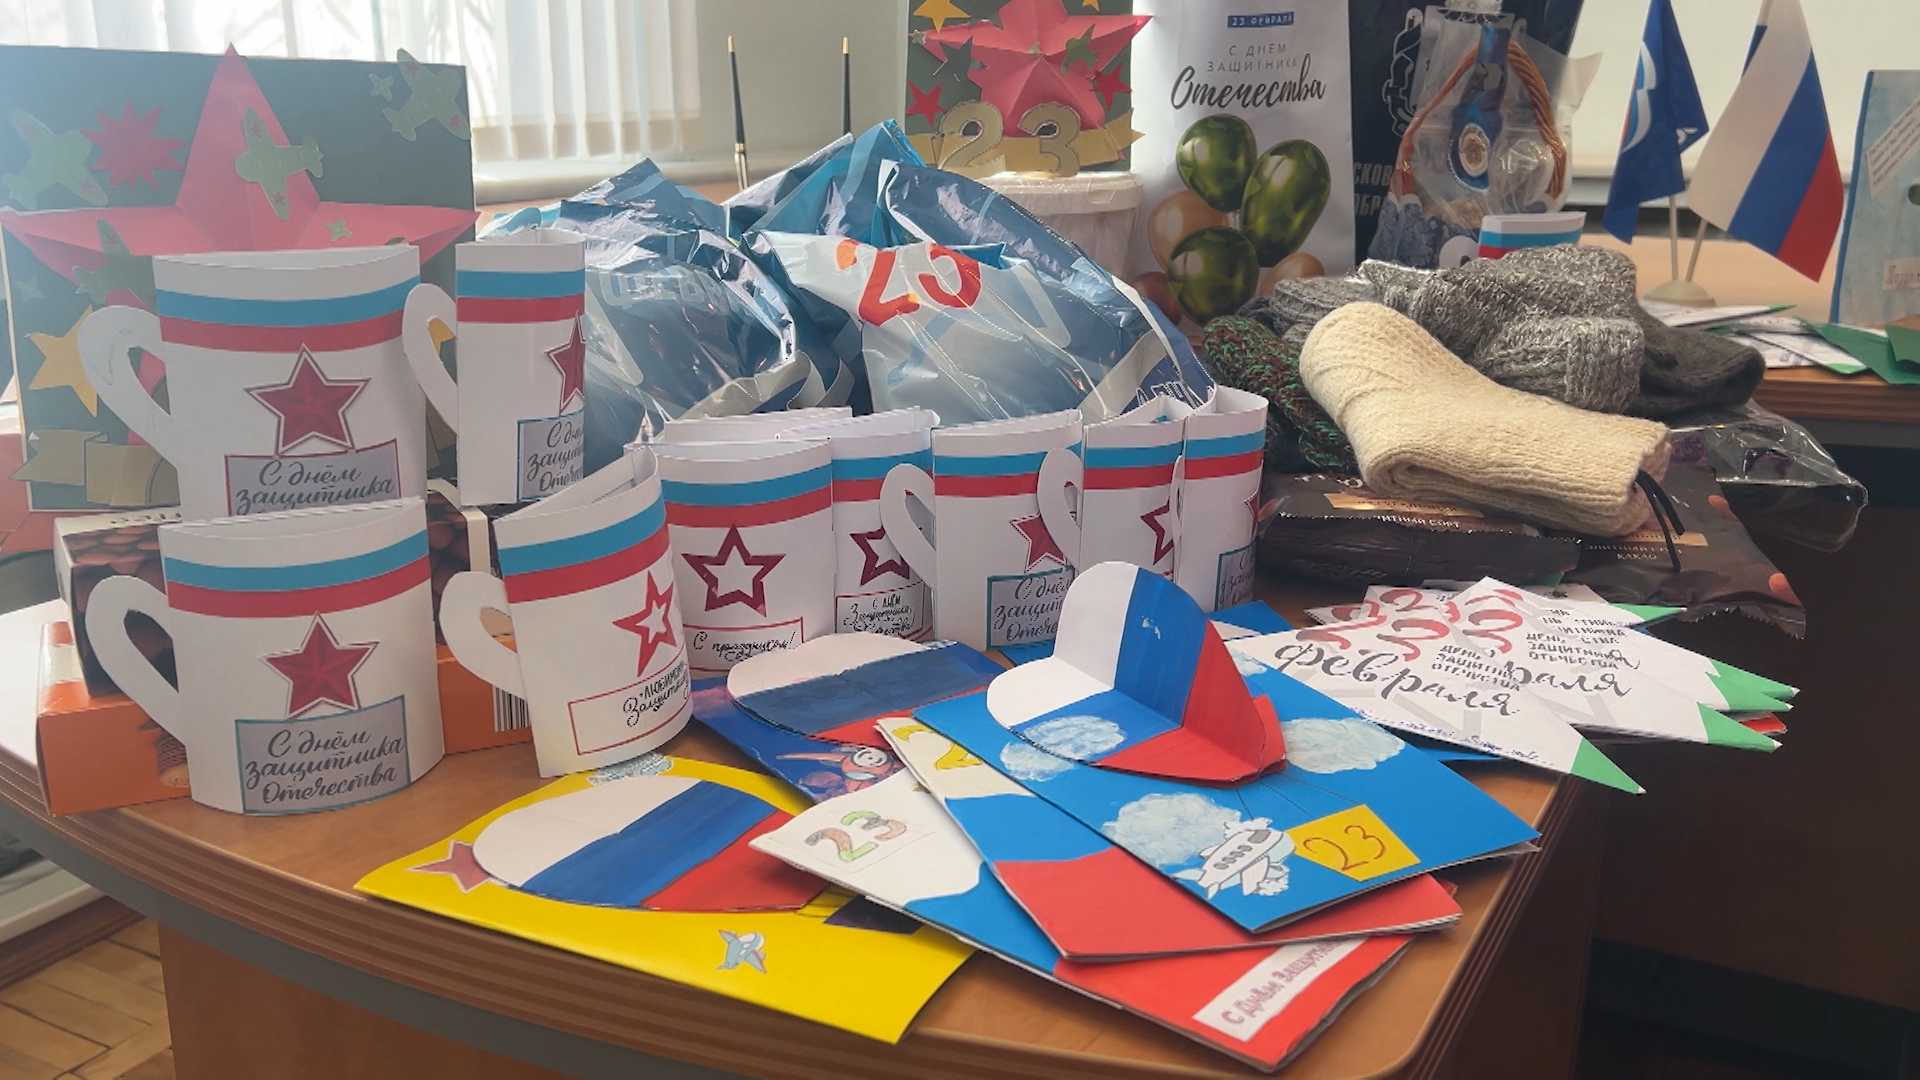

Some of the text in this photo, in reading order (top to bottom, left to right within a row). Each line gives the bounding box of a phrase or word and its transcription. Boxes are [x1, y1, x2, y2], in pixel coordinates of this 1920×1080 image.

[1232, 12, 1293, 26] 23 ФЕВРАЛЯ
[1207, 57, 1298, 73] ЗАЩИТНИКА
[1229, 43, 1287, 57] С ДНЕМ
[1170, 53, 1327, 110] Отечества
[938, 100, 1082, 178] 23
[547, 421, 562, 448] С
[259, 459, 282, 486] С
[235, 475, 396, 516] защитника
[1015, 577, 1033, 600] С
[267, 729, 371, 758] С днём
[245, 735, 406, 790] защитника
[262, 761, 398, 804] Отечества
[803, 810, 907, 863] 23
[1303, 824, 1386, 872] 23
